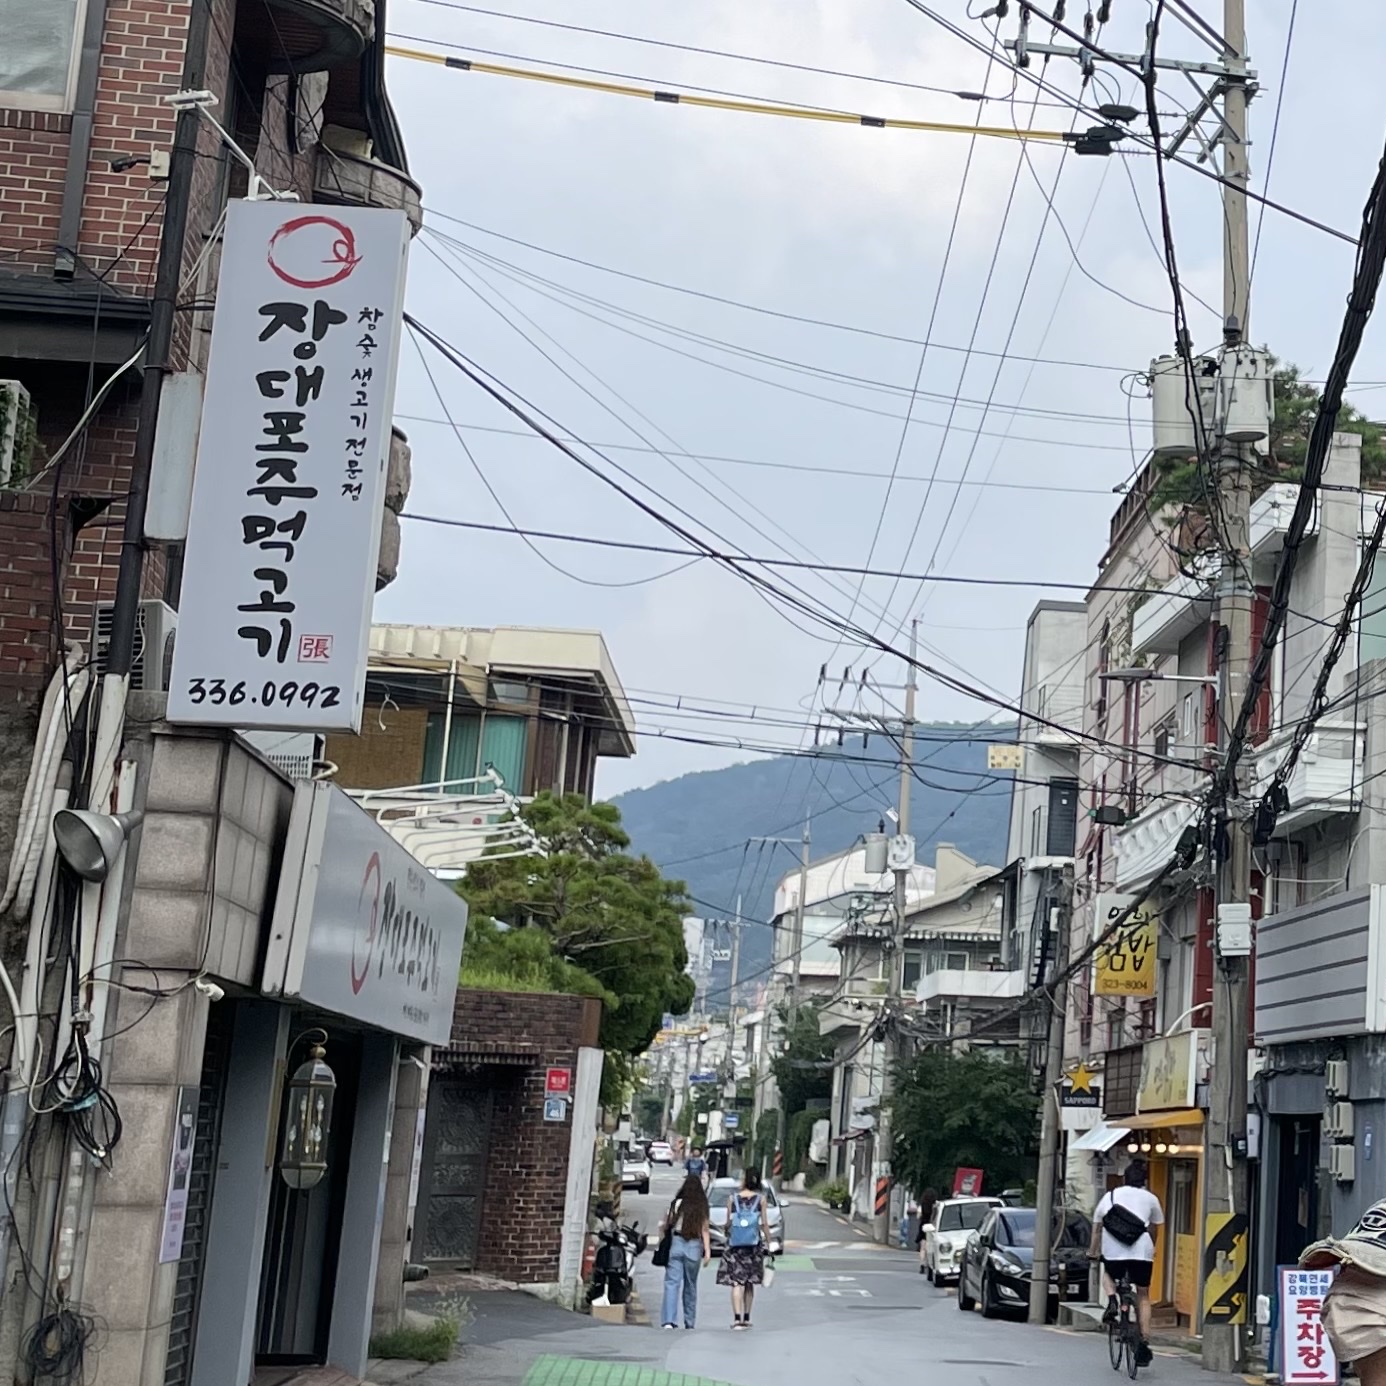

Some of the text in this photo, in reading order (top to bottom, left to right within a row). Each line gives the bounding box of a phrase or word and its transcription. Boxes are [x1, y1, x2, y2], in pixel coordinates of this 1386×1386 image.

[356, 306, 385, 359] 참숯
[237, 299, 348, 664] 장대포주먹고기
[188, 677, 341, 708] 336.0992
[1064, 1096, 1097, 1105] SAPPORO
[1296, 1298, 1326, 1369] 주차장
